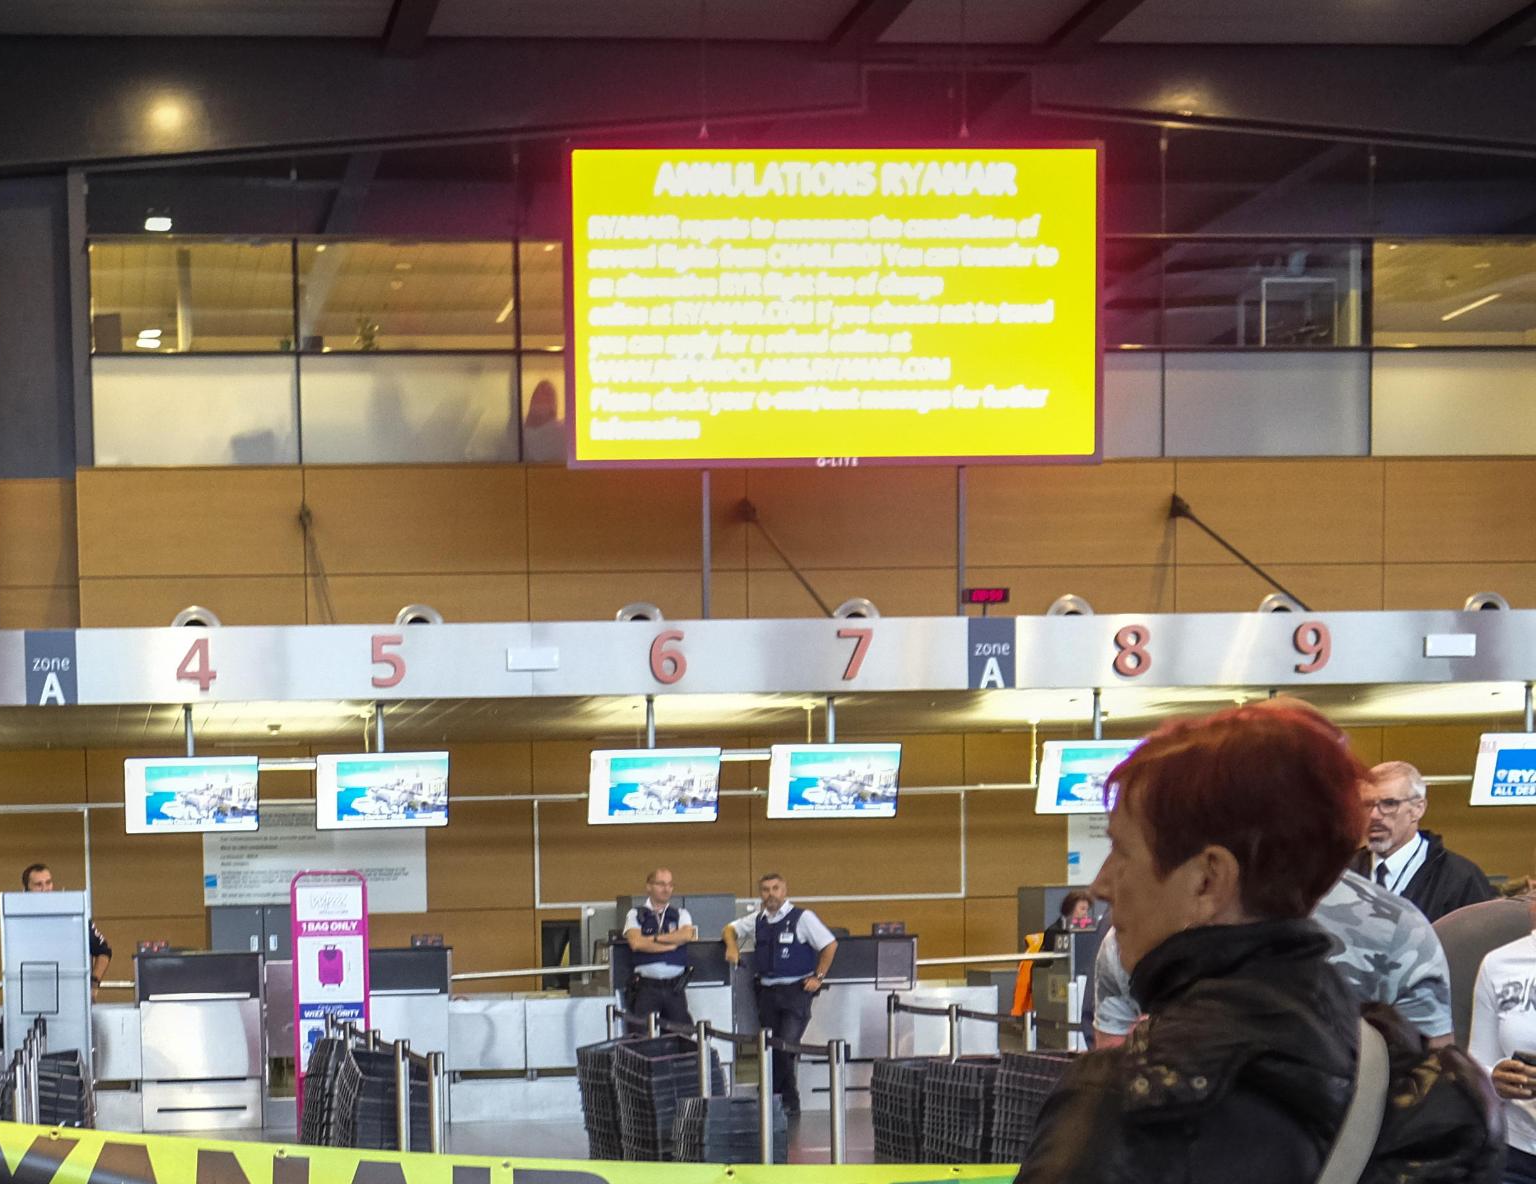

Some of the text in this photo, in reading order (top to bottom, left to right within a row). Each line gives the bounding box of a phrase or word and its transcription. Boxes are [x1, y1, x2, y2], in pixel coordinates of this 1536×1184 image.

[880, 161, 1018, 196] RYANAIR
[32, 656, 71, 673] zone
[176, 637, 218, 692] 4
[370, 634, 408, 689] 5
[649, 629, 688, 685] 6
[836, 628, 874, 681] 7
[975, 642, 1011, 656] zone
[1113, 624, 1152, 678] 8
[1293, 621, 1332, 674] 9
[39, 673, 66, 706] A
[980, 656, 1005, 689] A
[307, 922, 329, 931] BAG
[330, 921, 358, 931] ONLY
